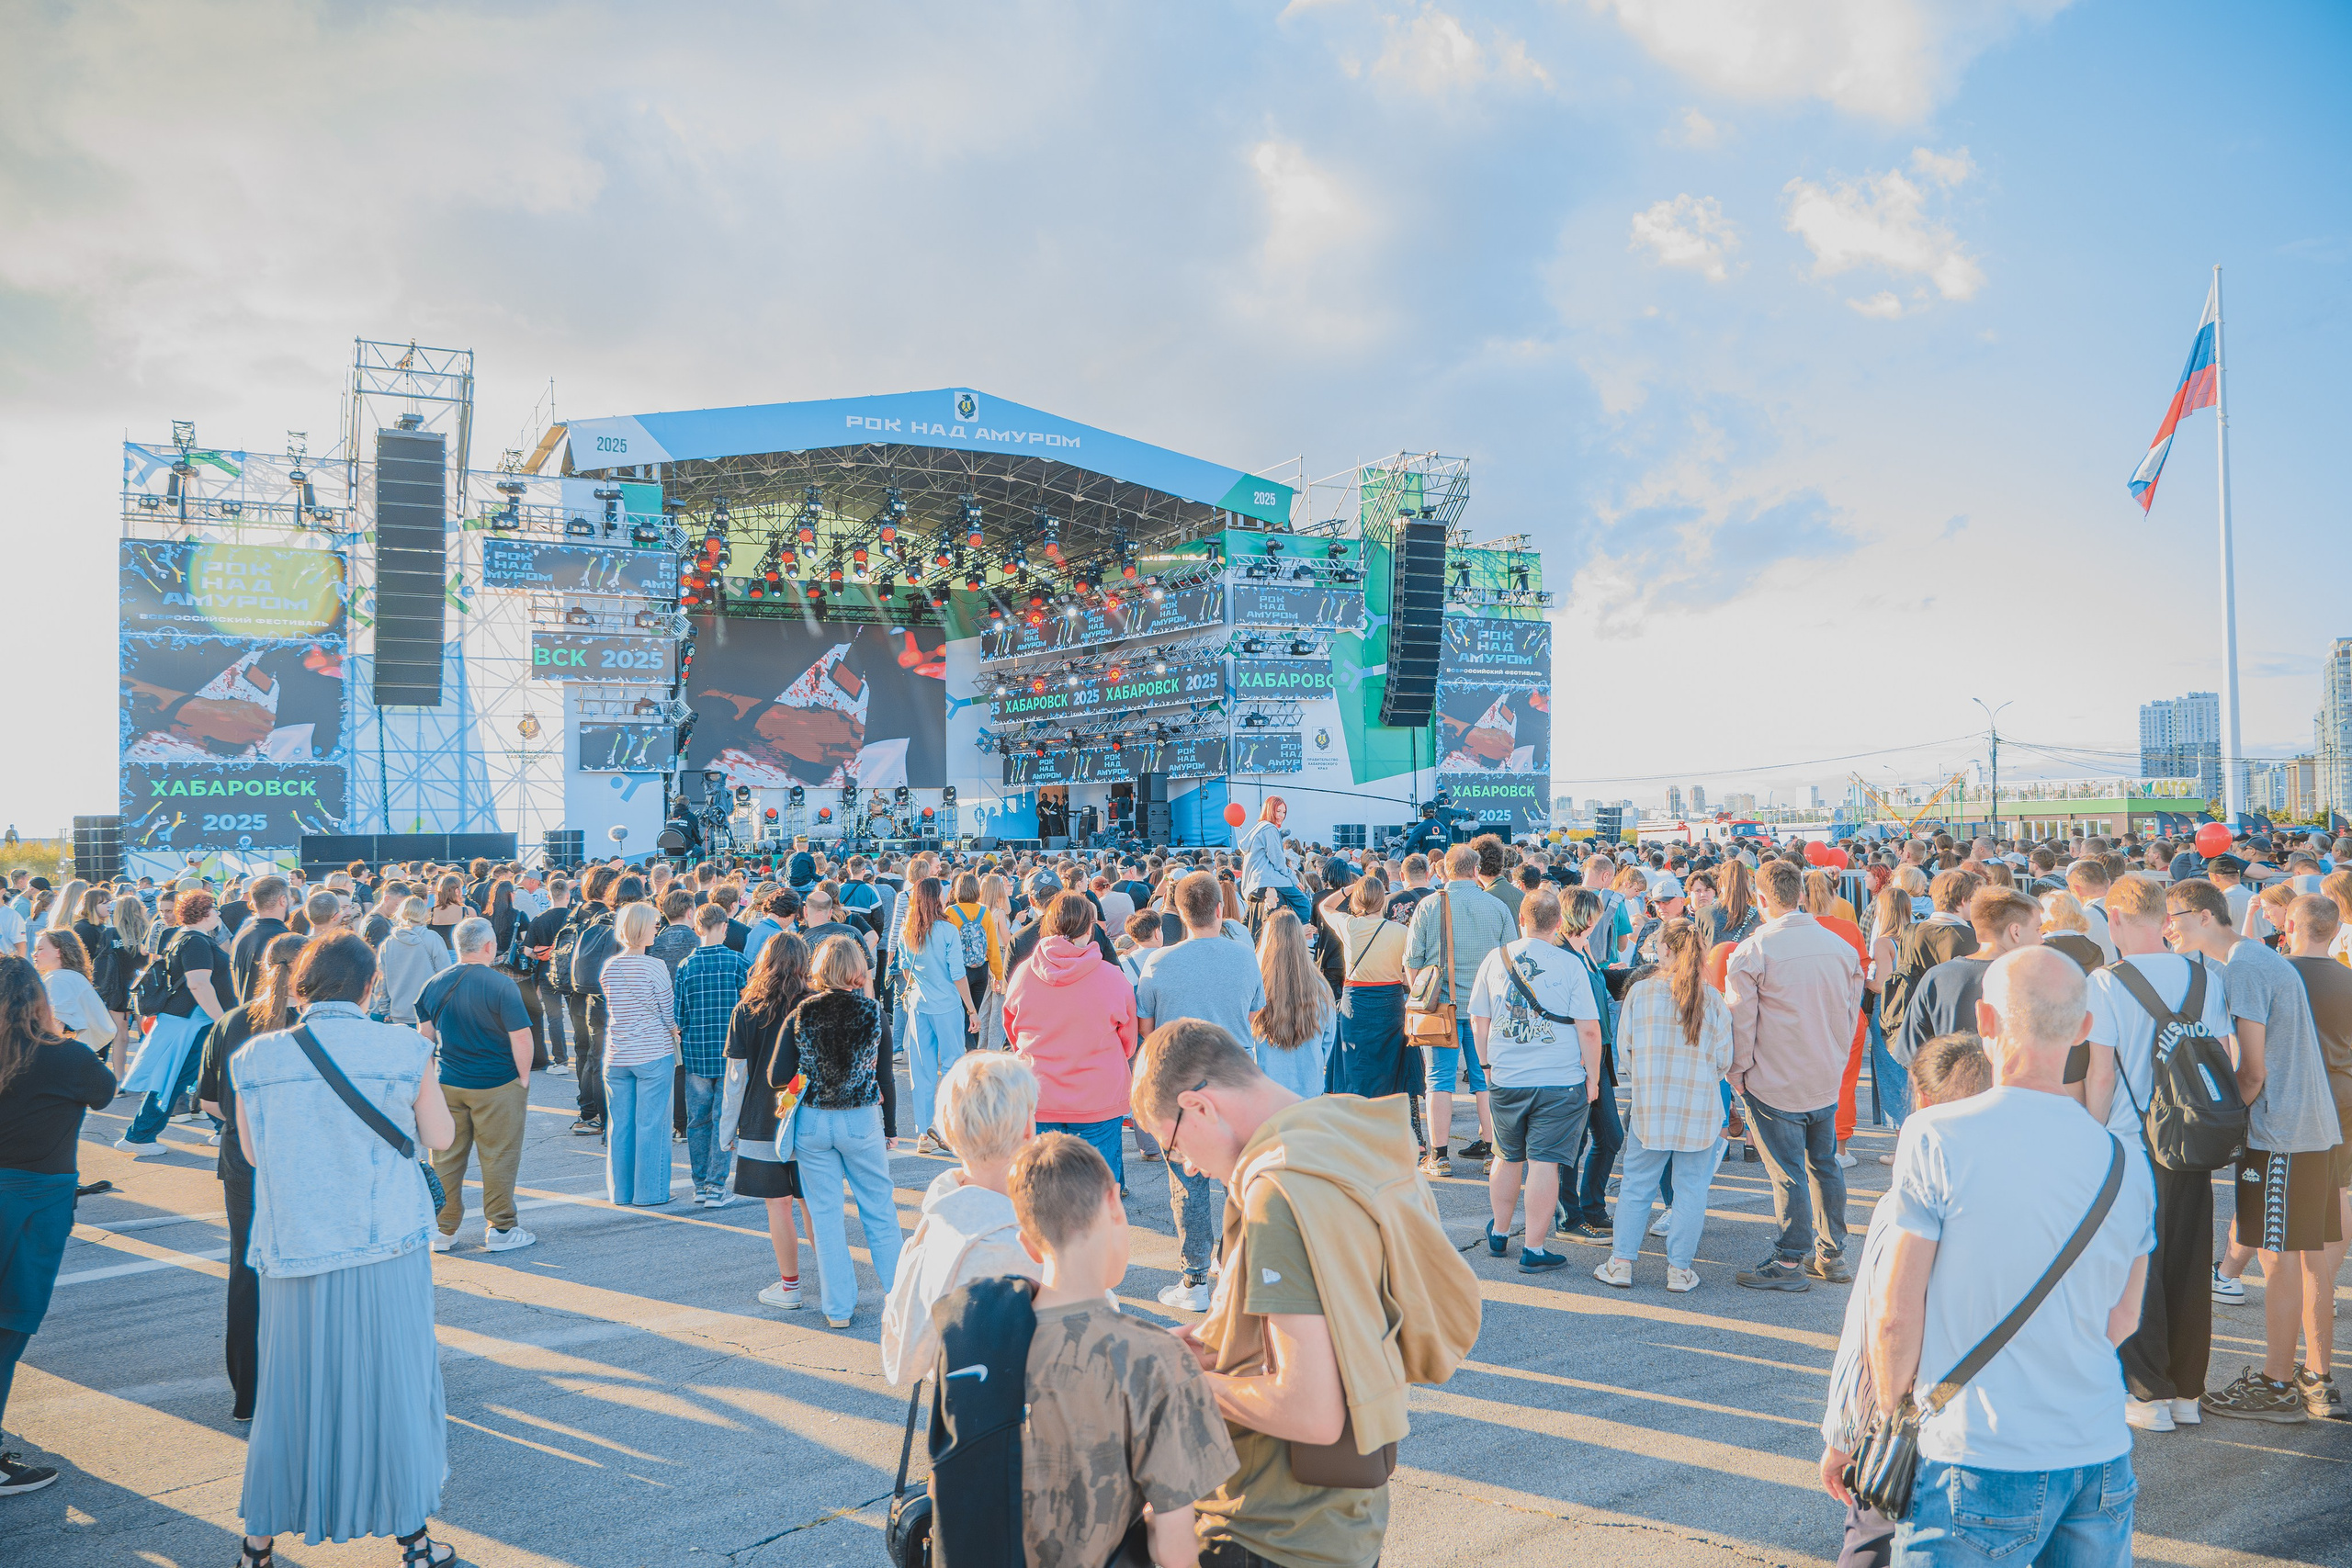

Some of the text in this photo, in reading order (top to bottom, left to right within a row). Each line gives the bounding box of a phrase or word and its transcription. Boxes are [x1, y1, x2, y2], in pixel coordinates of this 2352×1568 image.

[846, 415, 1080, 448] РОК НАД АМУРОМ
[597, 436, 628, 453] 2025
[1254, 491, 1276, 505] 2025
[494, 551, 533, 561] РОК
[201, 561, 272, 577] РОК
[494, 560, 534, 571] НАД
[201, 577, 274, 592] НАД
[163, 592, 309, 611] АМУРОМ
[1160, 600, 1178, 610] РОК
[1260, 595, 1285, 604] РОК
[1160, 608, 1178, 617] НАД
[1247, 610, 1298, 619] АМУРОМ
[139, 613, 330, 627] ВСЕРОССИЙСКИЙ ФЕСТИВАЛЬ
[1088, 615, 1104, 624] РОК
[1151, 615, 1187, 626] АМУРОМ
[1023, 627, 1039, 636] РОК
[1088, 622, 1104, 631] НАД
[1080, 627, 1113, 639] АМУРОМ
[1478, 629, 1514, 641] РОК
[1017, 640, 1046, 650] АМУРОМ
[1477, 641, 1515, 653] НАД
[533, 648, 664, 669] ВСК 2025
[1458, 652, 1532, 665] АМУРОМ
[1005, 693, 1069, 714] ХАБАРОВСК
[1073, 688, 1100, 705] 2025
[1106, 677, 1180, 702] ХАБАРОВСК
[1185, 671, 1217, 692] 2025
[1177, 747, 1195, 755] РОК
[1097, 768, 1129, 776] АМУРОМ
[1169, 761, 1205, 772] АМУРОМ
[1032, 772, 1061, 780] АМУРОМ
[151, 780, 317, 796] ХАБАРОВСК
[1453, 785, 1535, 797] ХАБАРОВСК
[1479, 809, 1511, 822] 2025
[202, 814, 268, 831] 2025
[1519, 1020, 1556, 1043] WEAR
